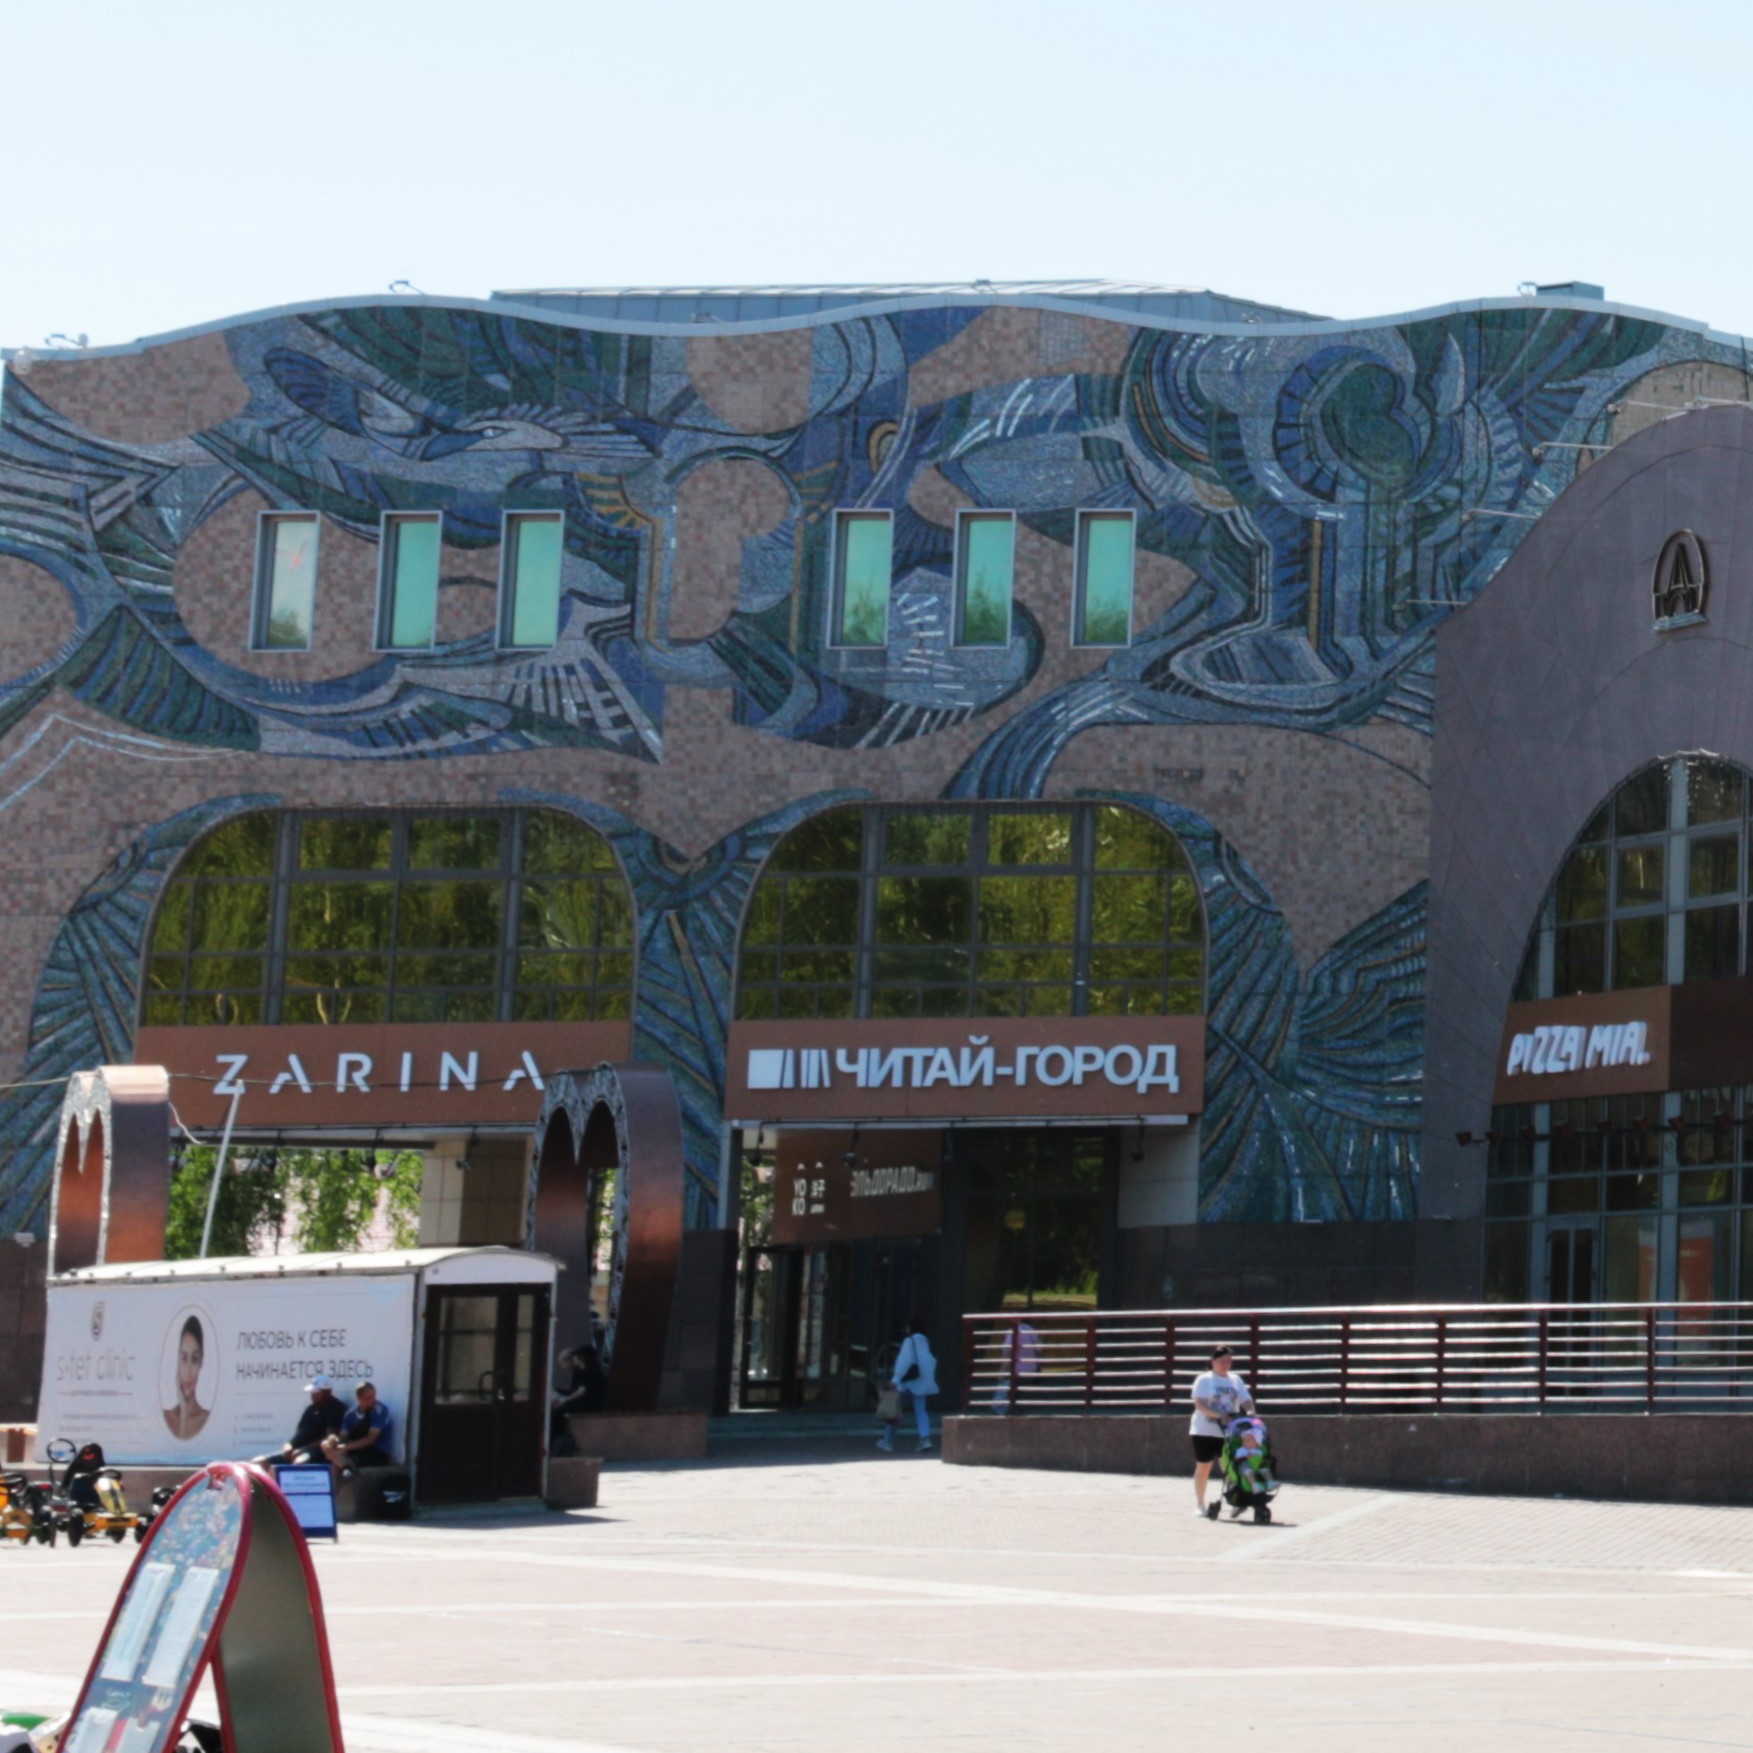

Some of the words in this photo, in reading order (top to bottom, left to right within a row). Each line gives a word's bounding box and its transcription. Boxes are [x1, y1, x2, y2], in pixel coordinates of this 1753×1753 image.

[213, 1050, 547, 1095] ZARINA
[836, 1035, 1180, 1094] ЧИТАЙ-ГОРОД
[1508, 1025, 1584, 1075] PIZZA
[236, 1330, 294, 1351] ЛЮБОВЬ
[297, 1330, 307, 1348] К
[309, 1327, 347, 1348] СЕБЕ
[236, 1360, 324, 1380] НАЧИНАЕТСЯ
[328, 1358, 374, 1380] ЗДЕСЬ
